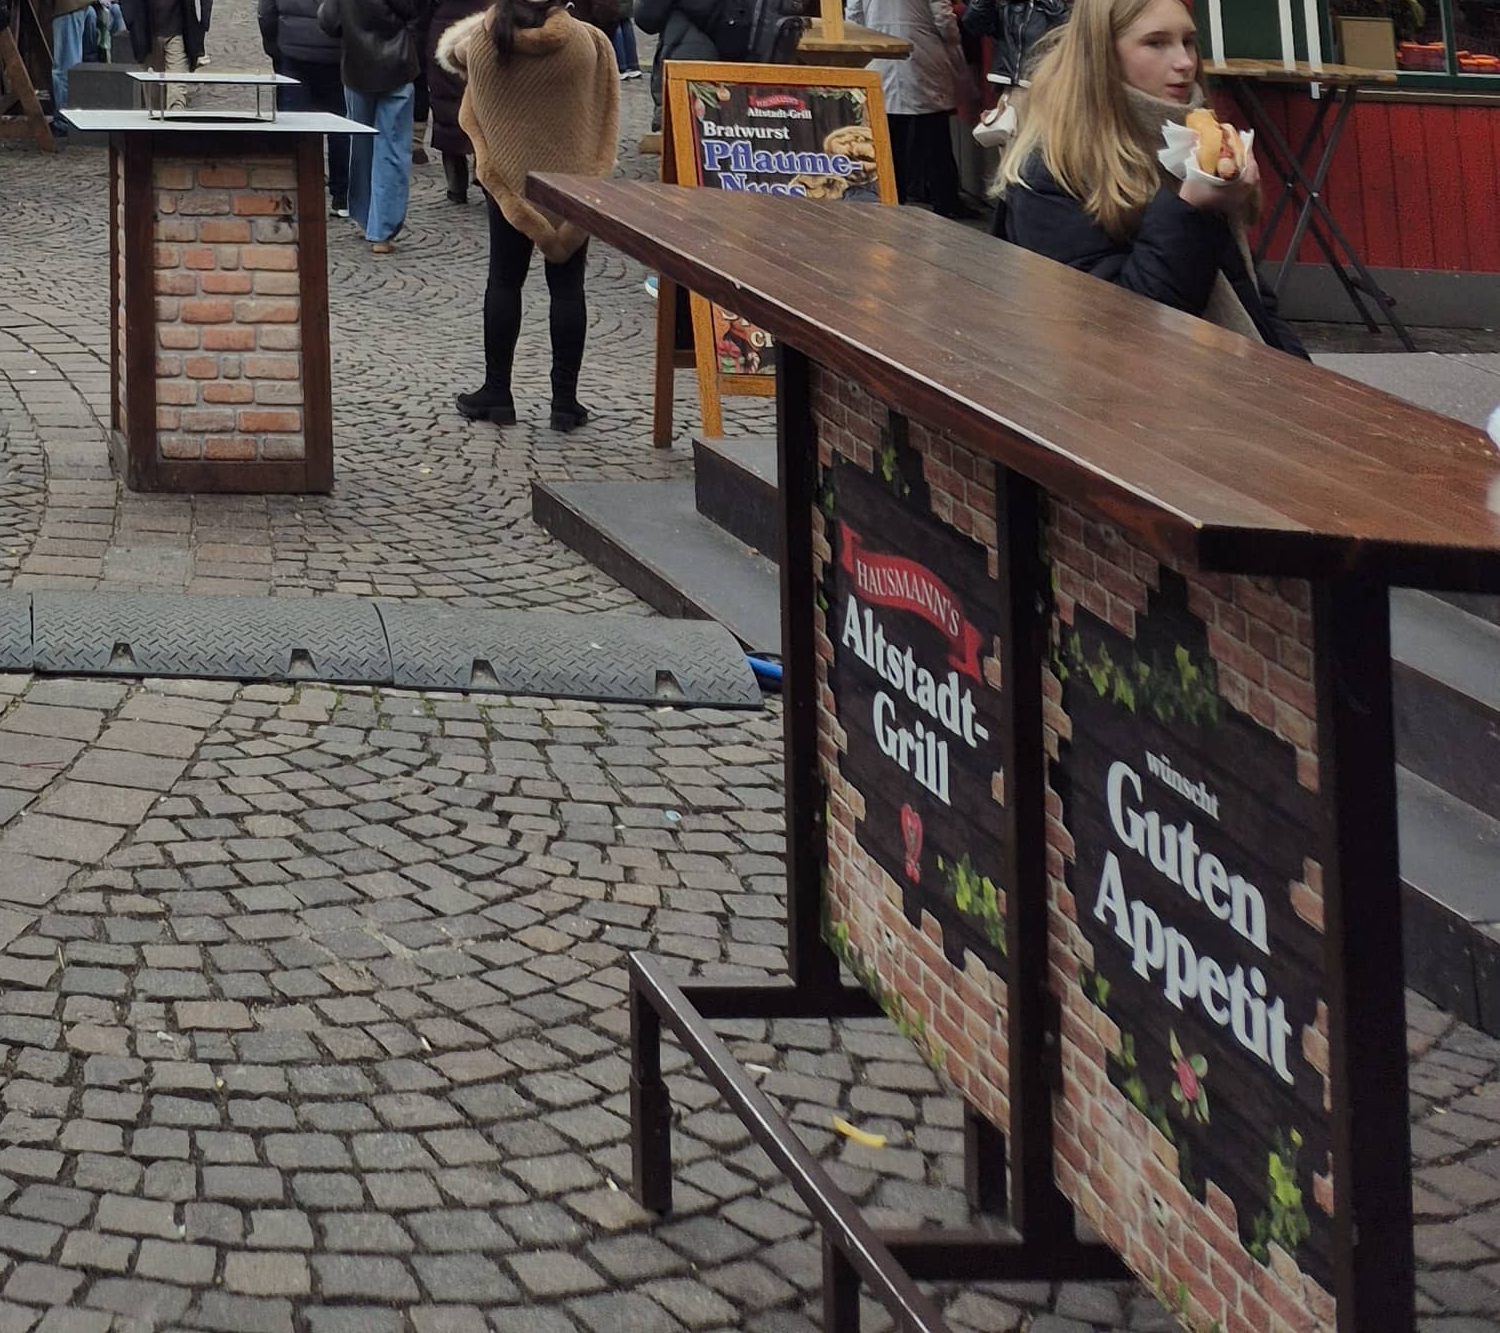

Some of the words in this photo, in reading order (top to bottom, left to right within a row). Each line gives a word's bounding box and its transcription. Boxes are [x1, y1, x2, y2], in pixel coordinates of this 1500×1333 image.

[701, 139, 863, 176] Pflaume-
[702, 121, 790, 140] Bratwurst
[855, 557, 960, 638] HAUSMANN'S
[841, 593, 990, 749] Altstadt-
[872, 690, 952, 807] Grill
[1145, 749, 1220, 822] wünscht
[1106, 760, 1272, 957] Guten
[1092, 849, 1296, 1086] Appetit
